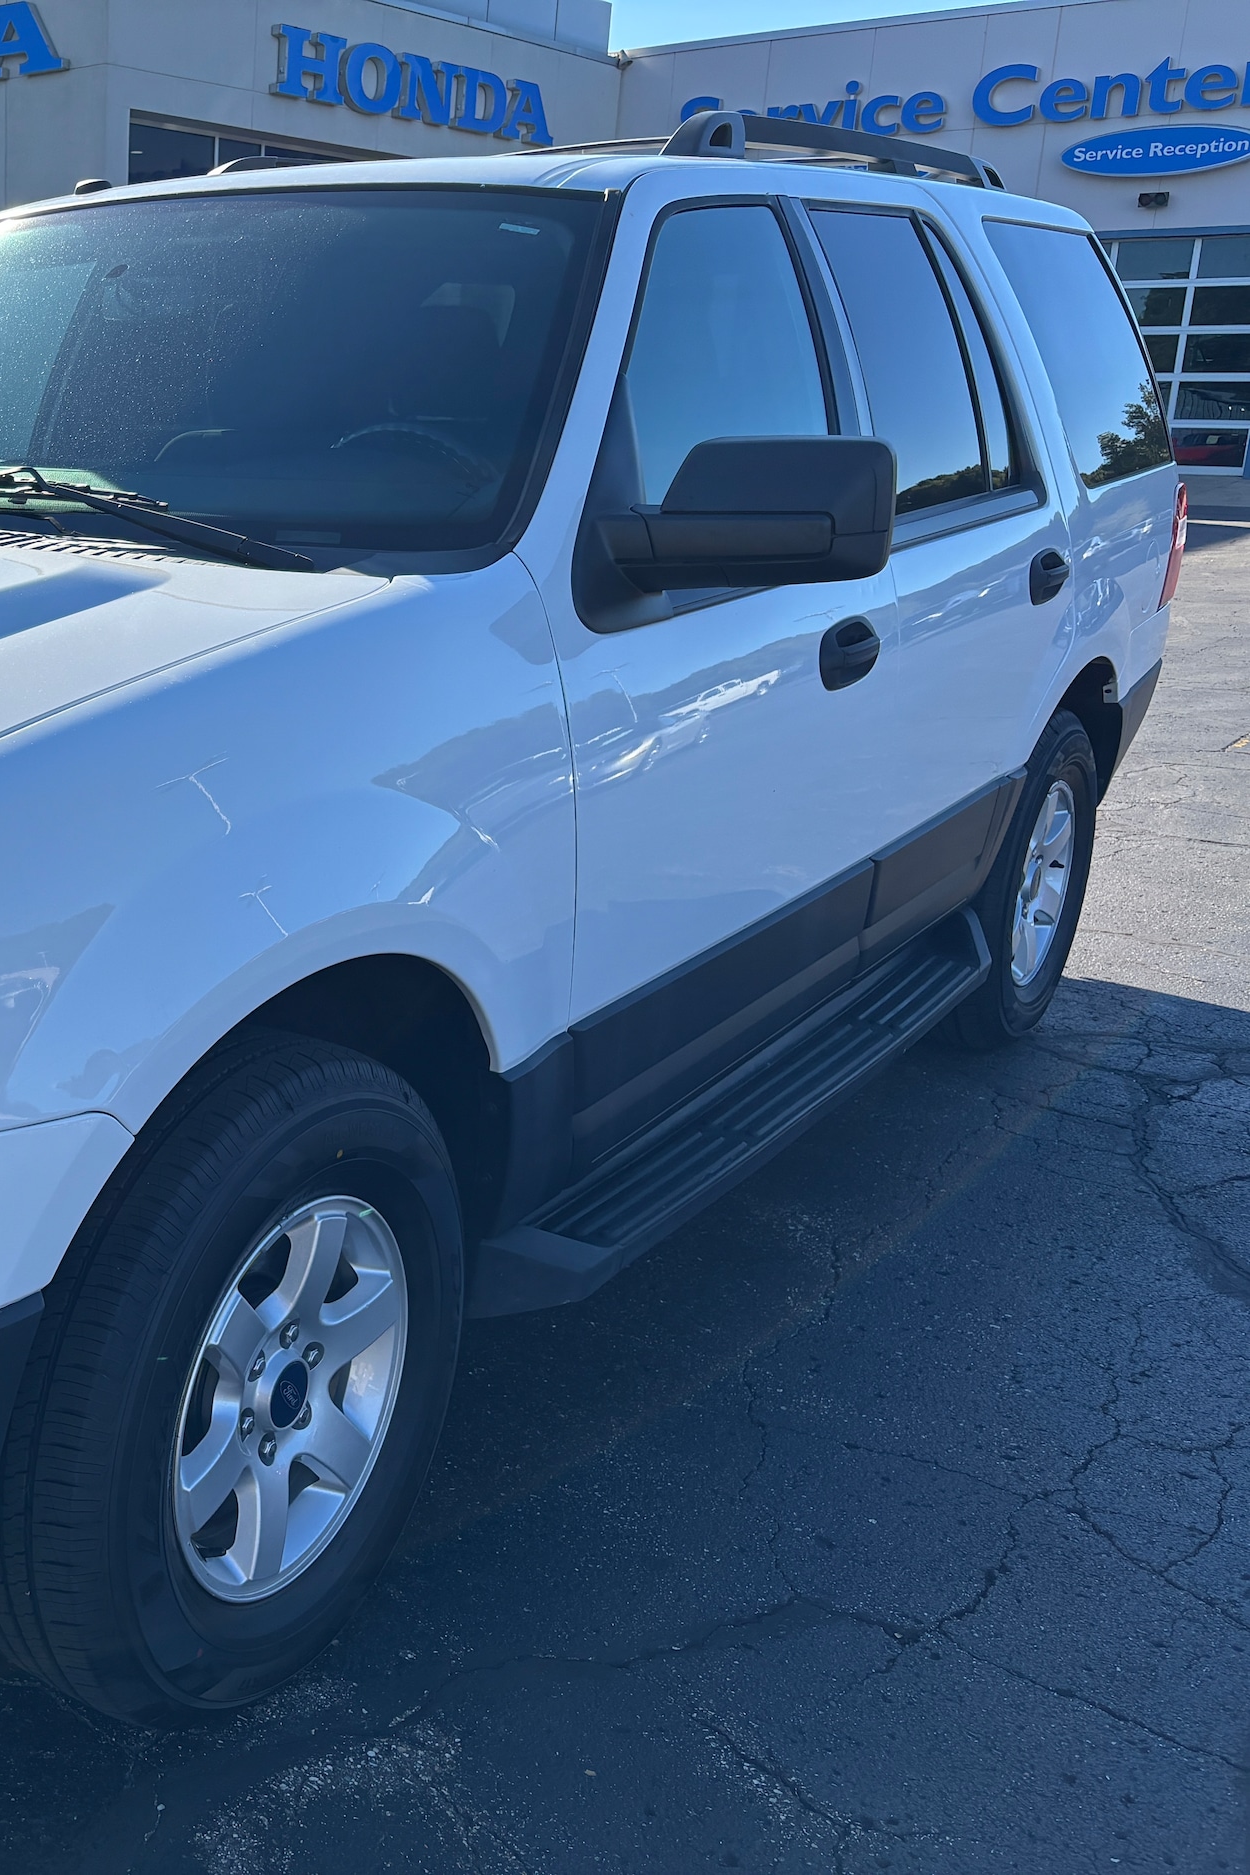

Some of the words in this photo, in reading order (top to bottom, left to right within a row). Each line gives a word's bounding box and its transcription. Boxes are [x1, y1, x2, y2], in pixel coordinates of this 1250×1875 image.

[271, 23, 554, 147] HONDA
[680, 80, 947, 136] vice
[1072, 145, 1144, 162] Service
[1148, 137, 1250, 159] Reception
